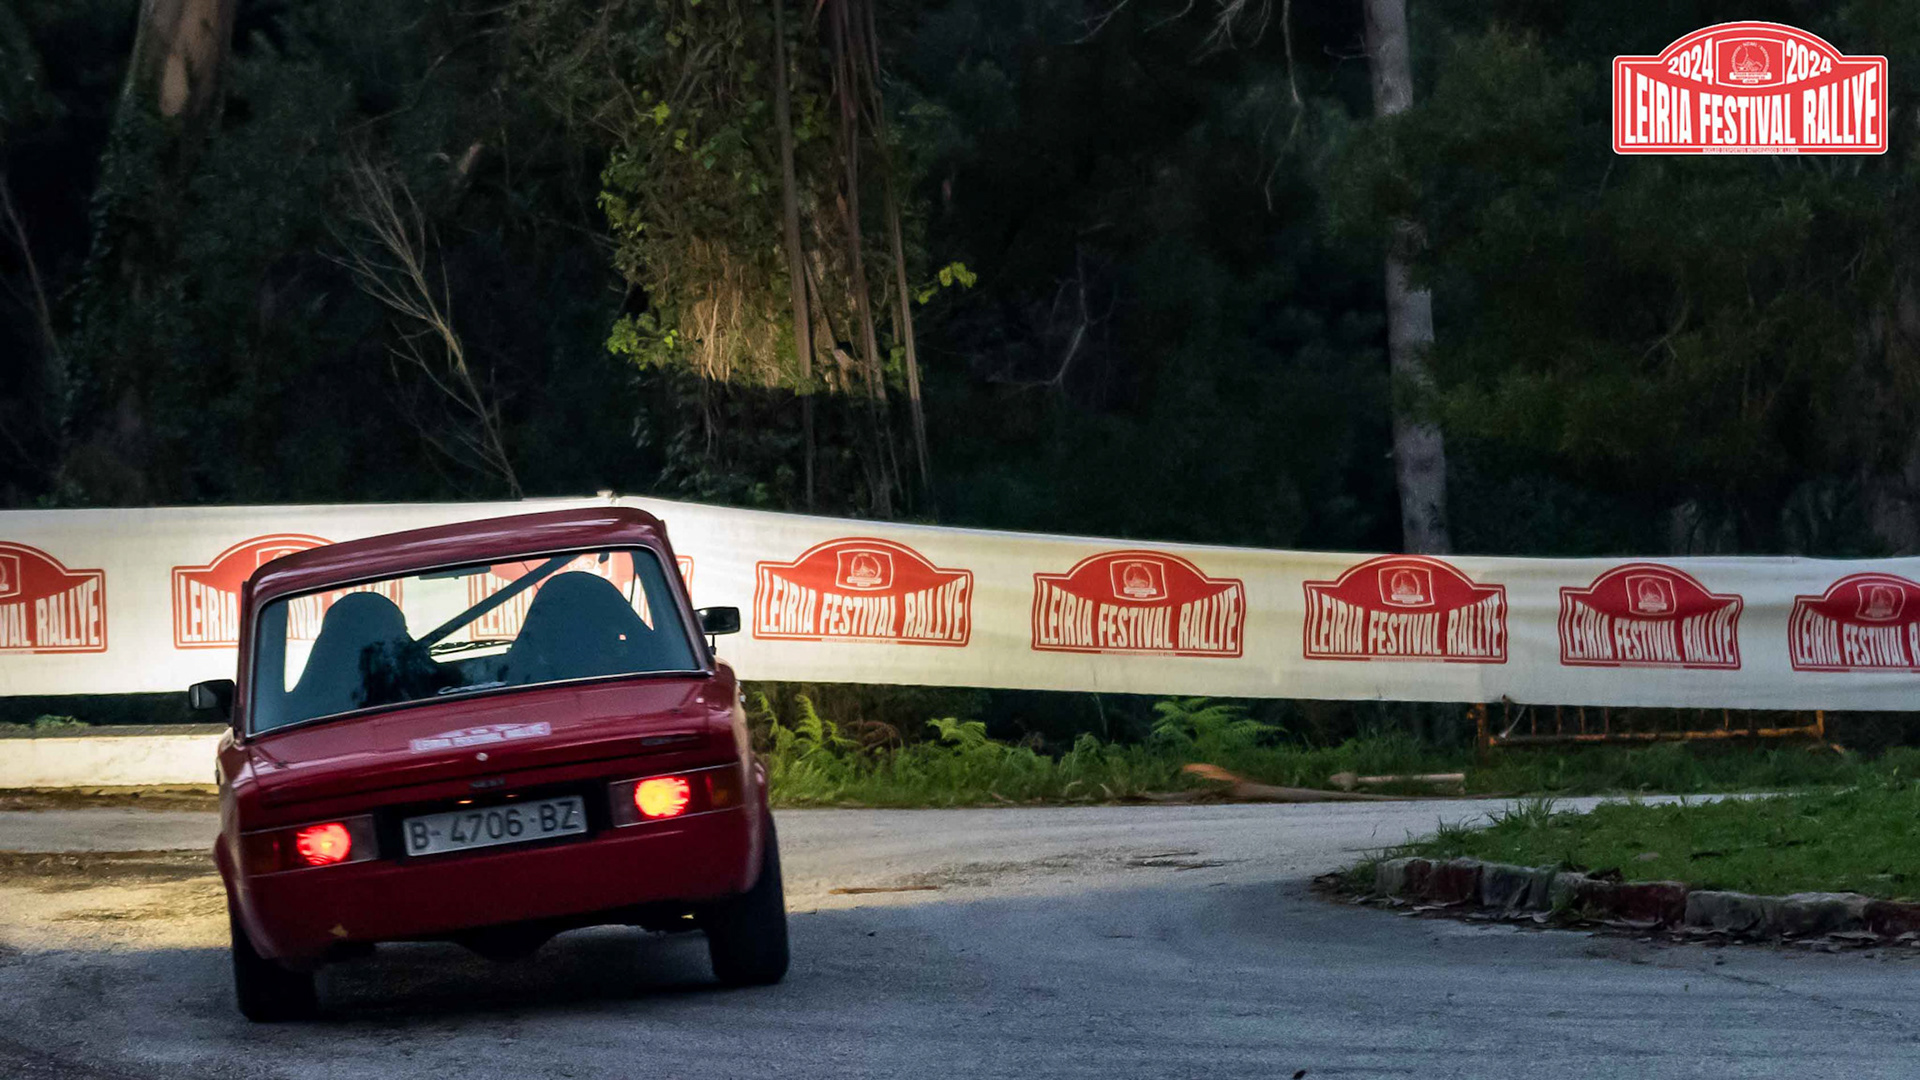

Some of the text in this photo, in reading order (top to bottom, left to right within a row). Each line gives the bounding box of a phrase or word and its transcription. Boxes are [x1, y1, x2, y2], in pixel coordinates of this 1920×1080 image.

[36, 577, 100, 647] RALLYE
[180, 574, 240, 641] LEIRIA
[760, 569, 816, 634] LEIRIA
[819, 592, 896, 637] FESTIVAL
[902, 576, 966, 640] RALLYE
[1039, 580, 1093, 646] LEIRIA
[1098, 603, 1173, 648] FESTIVAL
[1178, 585, 1237, 650] RALLYE
[1310, 589, 1500, 656] LEIRIA FESTIVAL RALLYE
[1564, 595, 1613, 660] LEIRIA
[1614, 617, 1681, 661] FESTIVAL
[1682, 601, 1738, 662] RALLYE
[1795, 603, 1841, 666] LEIRIA
[1843, 622, 1909, 666] FESTIVAL
